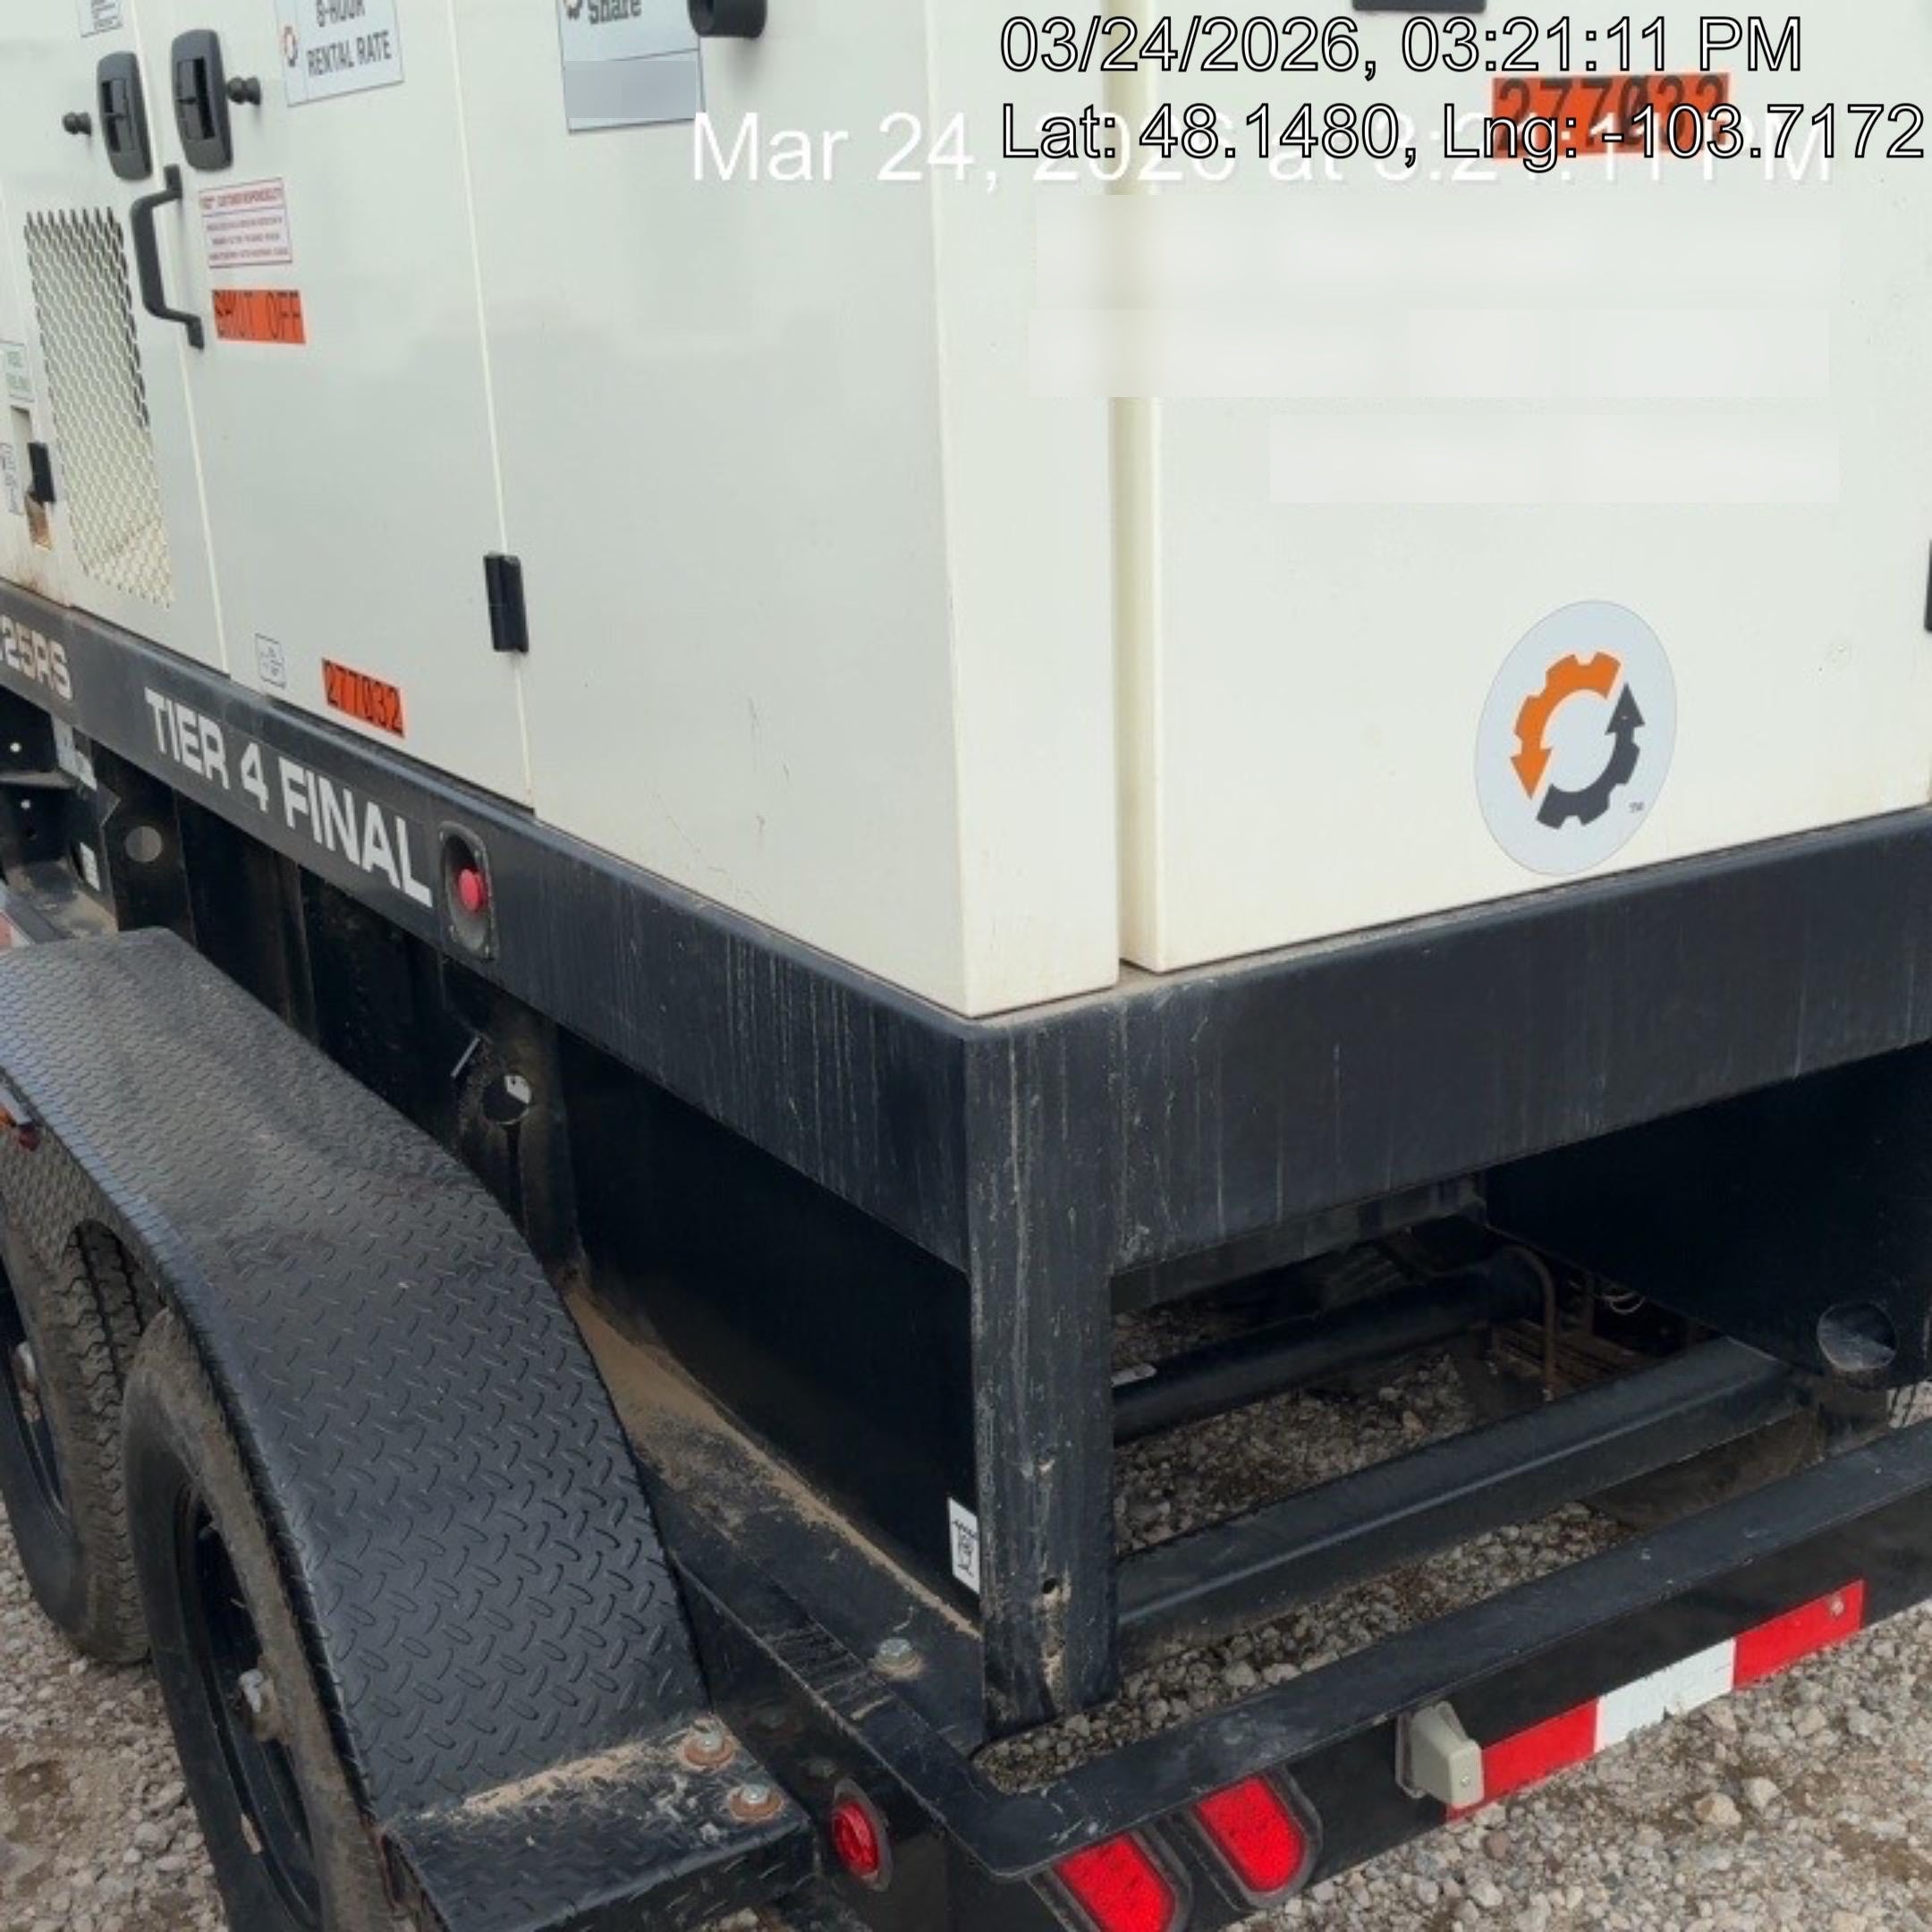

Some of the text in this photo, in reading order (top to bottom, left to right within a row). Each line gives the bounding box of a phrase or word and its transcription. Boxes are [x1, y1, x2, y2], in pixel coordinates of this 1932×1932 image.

[306, 30, 392, 77] RENTAL RATE
[144, 686, 433, 908] TIER 4 FINAL
